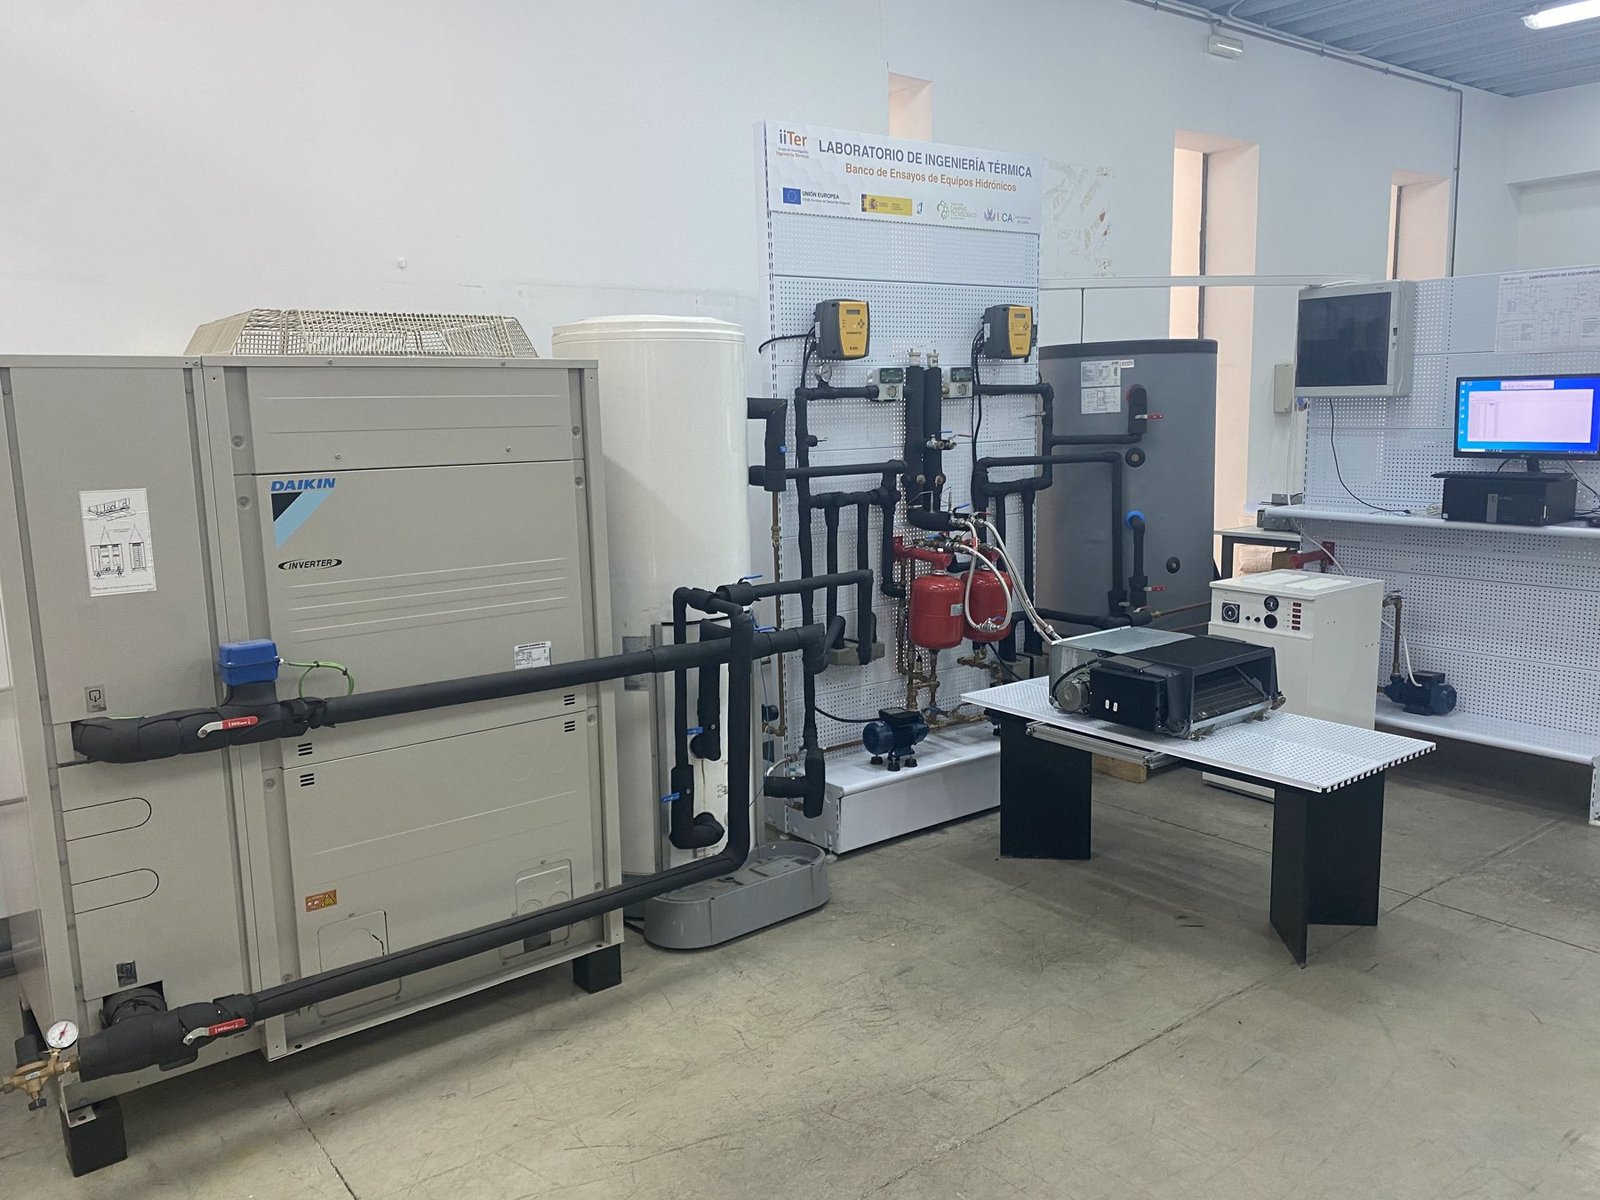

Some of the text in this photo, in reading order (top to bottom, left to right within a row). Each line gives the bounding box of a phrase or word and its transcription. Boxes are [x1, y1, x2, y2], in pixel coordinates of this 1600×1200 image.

[779, 129, 808, 147] iiTer
[819, 139, 904, 162] LABORATORIO
[907, 151, 922, 165] DE
[925, 153, 986, 172] INGENIERÍA
[988, 160, 1032, 178] TÉRMICA
[845, 163, 1017, 192] Banco de Ensayos de Equipos Hidrónicos
[817, 192, 840, 200] EUROPEA
[270, 478, 336, 492] DAIKIN
[288, 559, 333, 570] INVERTER
